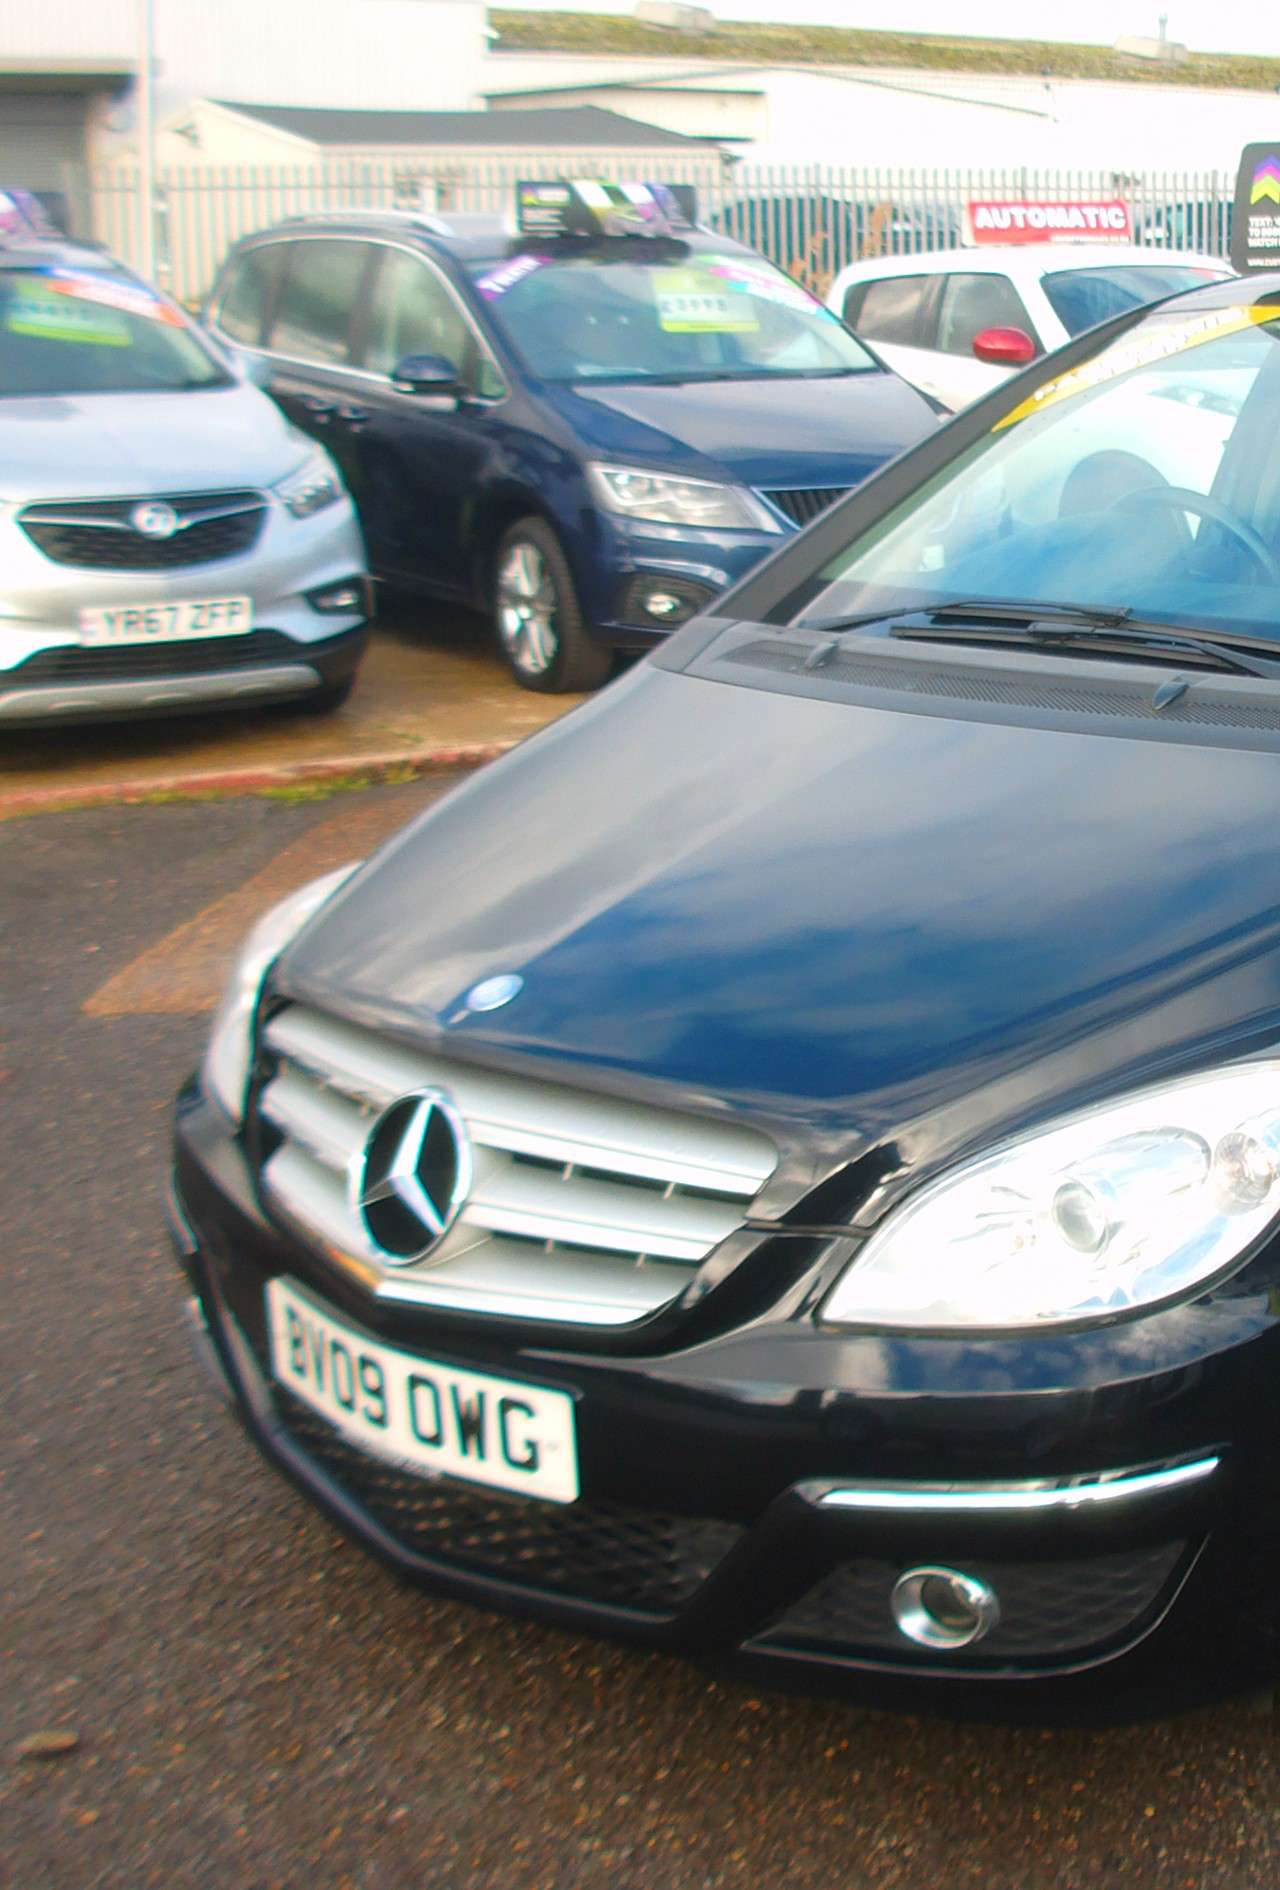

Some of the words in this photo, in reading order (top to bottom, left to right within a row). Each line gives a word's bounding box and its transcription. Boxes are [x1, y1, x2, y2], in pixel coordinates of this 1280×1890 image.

[975, 206, 1127, 229] AUTOMATIC
[1247, 237, 1278, 248] WATCH
[101, 605, 179, 636] YR67
[190, 599, 243, 630] ZFP
[285, 1304, 389, 1430] BV09
[407, 1372, 540, 1475] OWG
